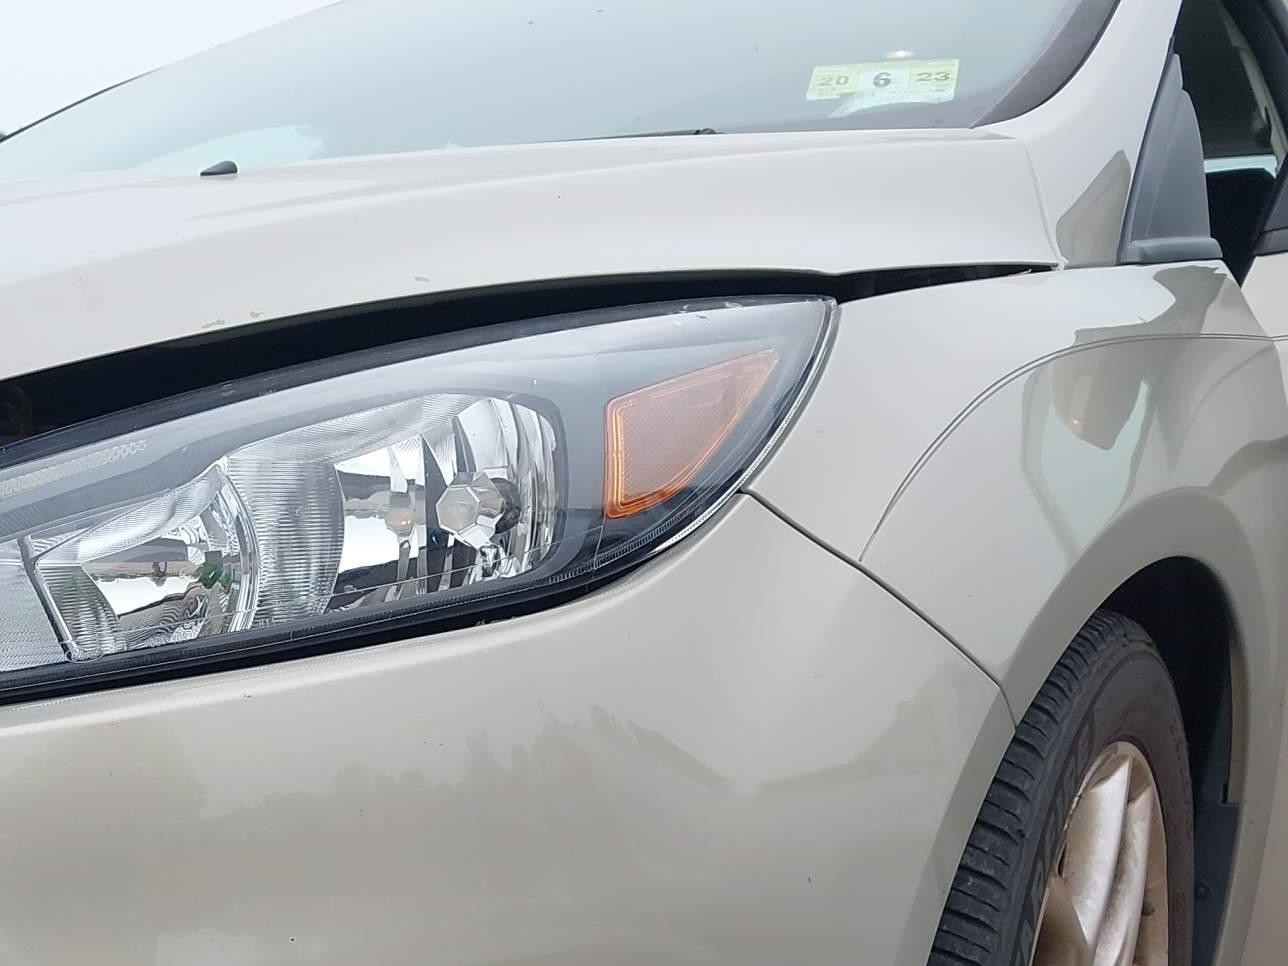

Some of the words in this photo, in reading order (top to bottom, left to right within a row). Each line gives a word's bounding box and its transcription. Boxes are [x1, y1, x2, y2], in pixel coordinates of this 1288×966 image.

[818, 76, 849, 86] 20
[873, 71, 892, 88] 6
[917, 71, 951, 82] 23
